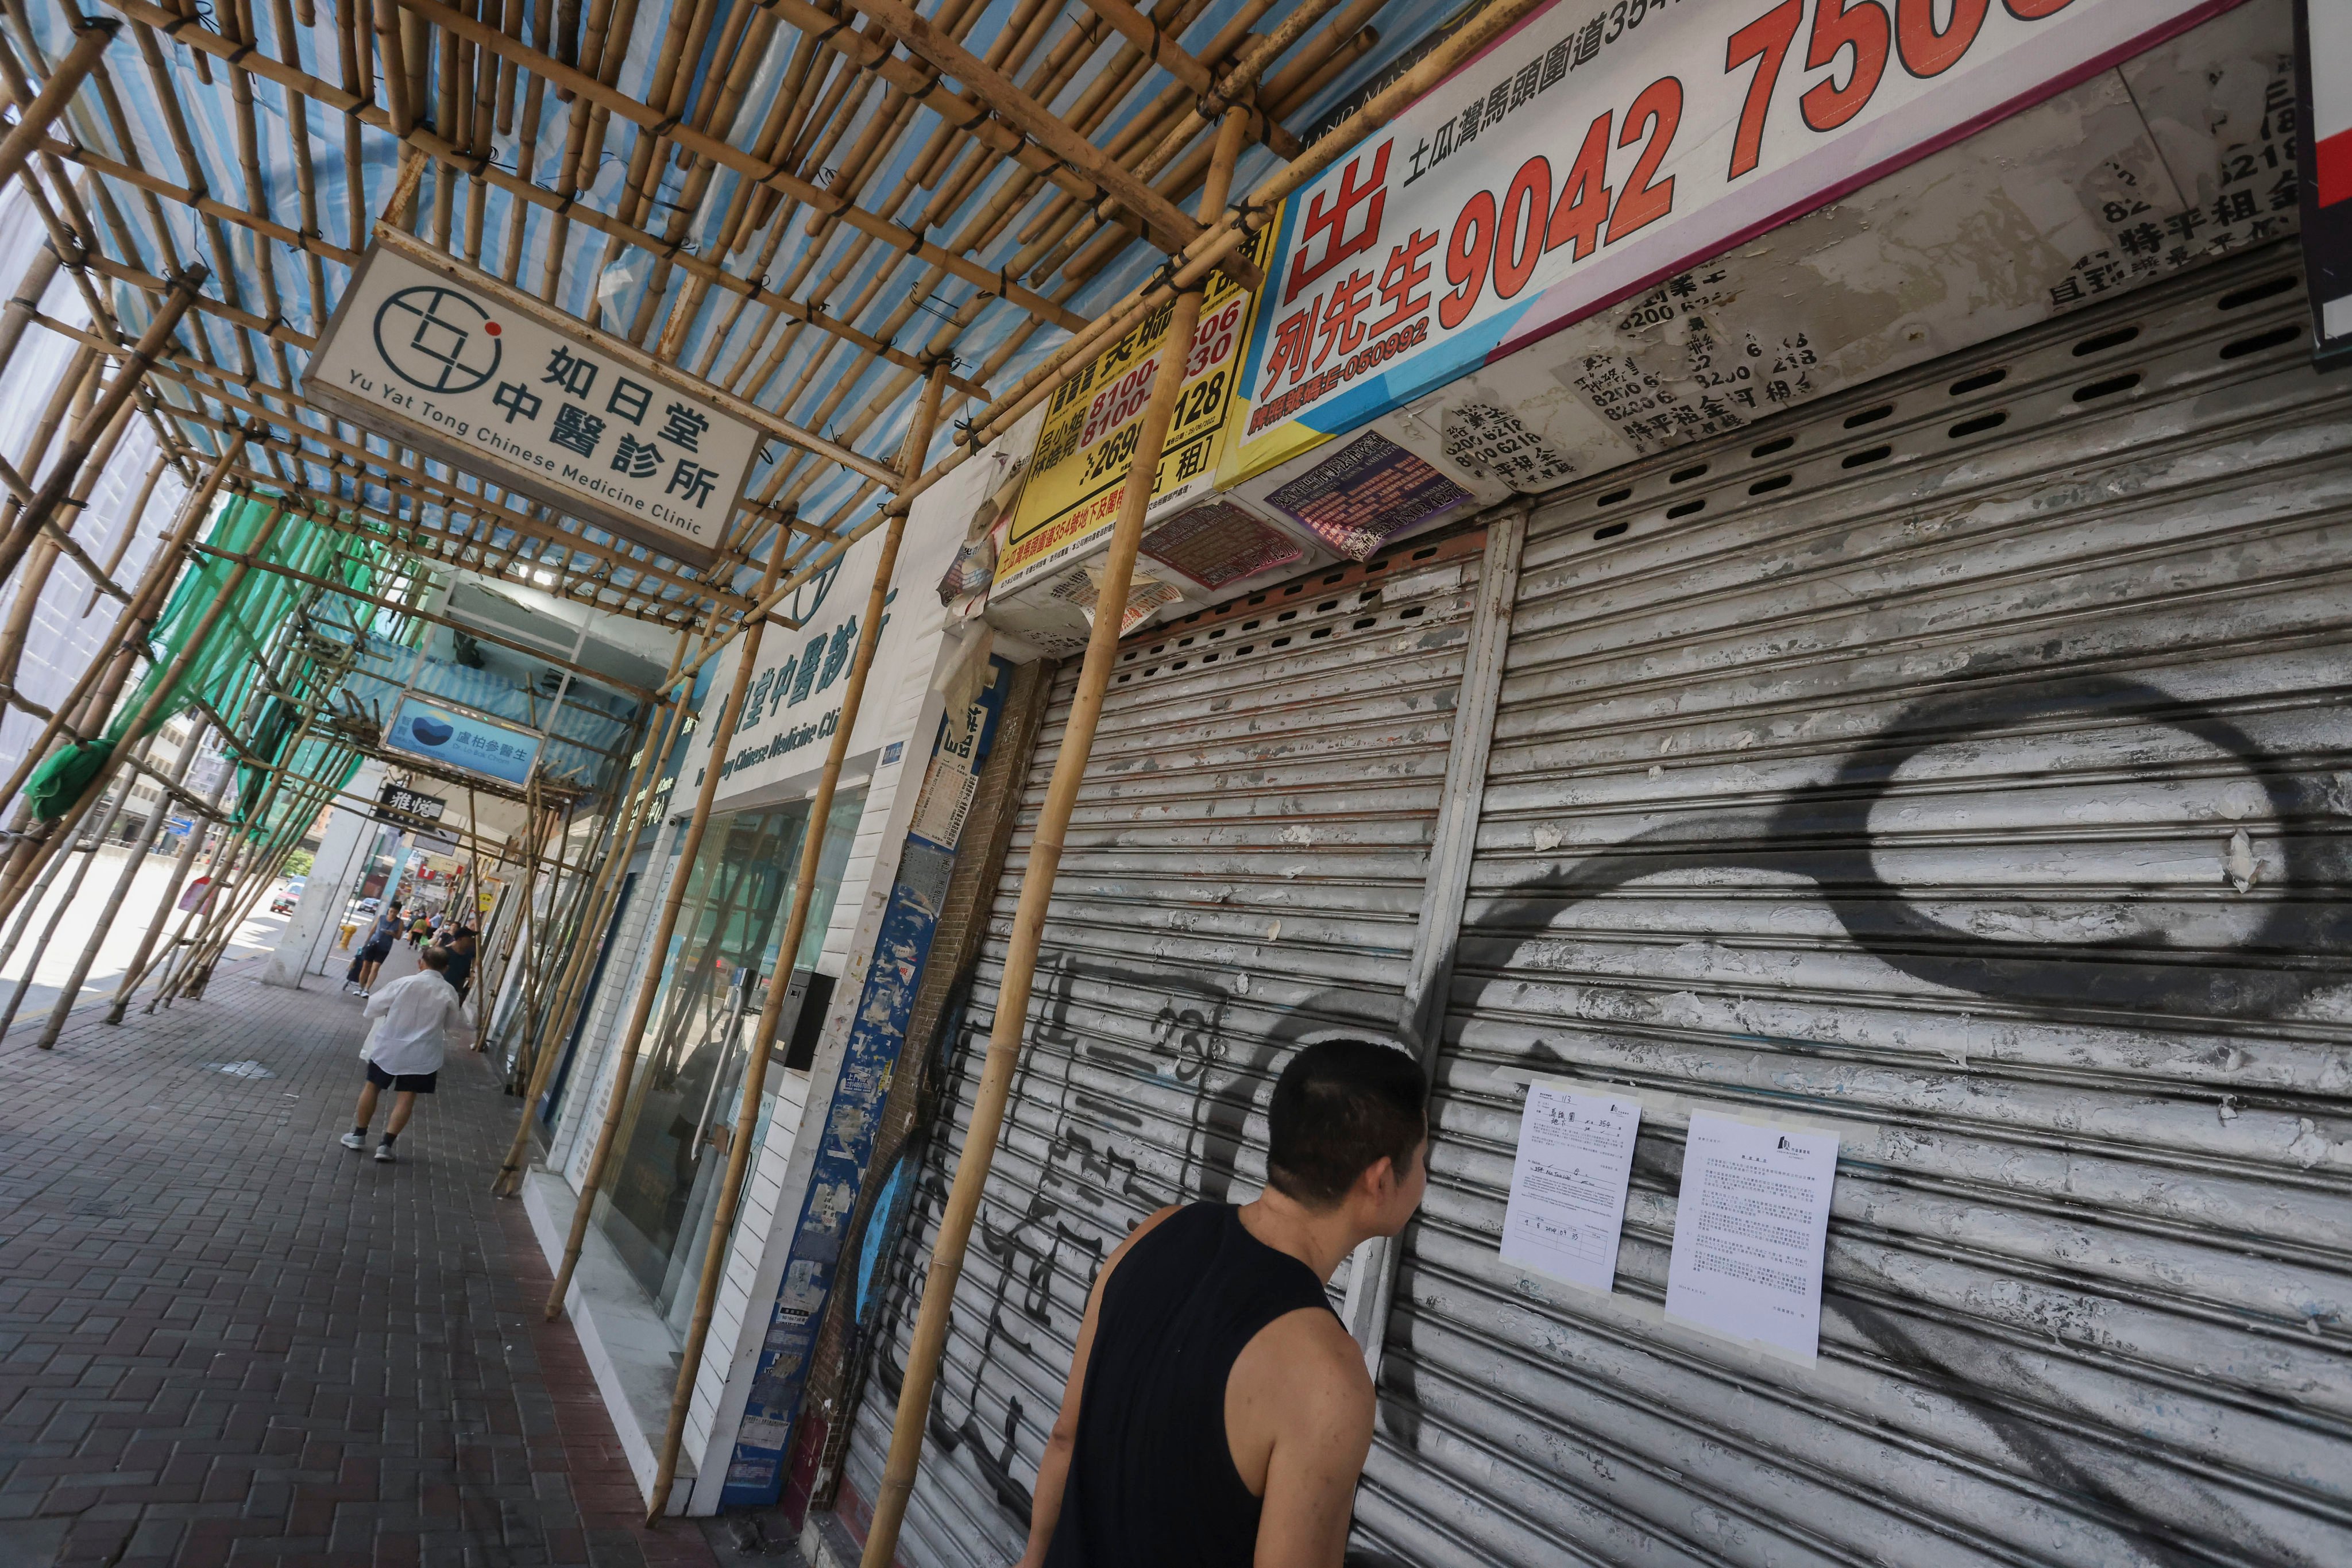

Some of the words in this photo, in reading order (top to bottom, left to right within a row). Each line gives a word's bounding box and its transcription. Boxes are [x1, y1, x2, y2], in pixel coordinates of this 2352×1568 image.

[1404, 0, 1680, 188] 土瓜灣馬頭圍道35
[1283, 137, 1395, 307] 出
[1438, 75, 1684, 330] 9042
[1725, 0, 2086, 183] 75
[1090, 300, 1241, 420] 8100-06
[1261, 228, 1439, 402] 列先生
[492, 381, 719, 509] 中醫診所
[542, 345, 709, 454] 如日堂
[1037, 407, 1087, 456] 呂小姐
[1080, 333, 1232, 447] 8100-30
[1174, 370, 1226, 431] 128
[349, 369, 373, 390] Yu
[382, 383, 414, 411] Yat
[422, 401, 469, 437] Tong
[476, 427, 555, 472] Chinese
[561, 463, 646, 511] Medicine
[651, 503, 702, 536] Clinic
[1393, 501, 1433, 526] 6803
[1430, 484, 1471, 508] 4276
[1455, 447, 1498, 468] 800
[707, 588, 898, 748] 堂中醫診
